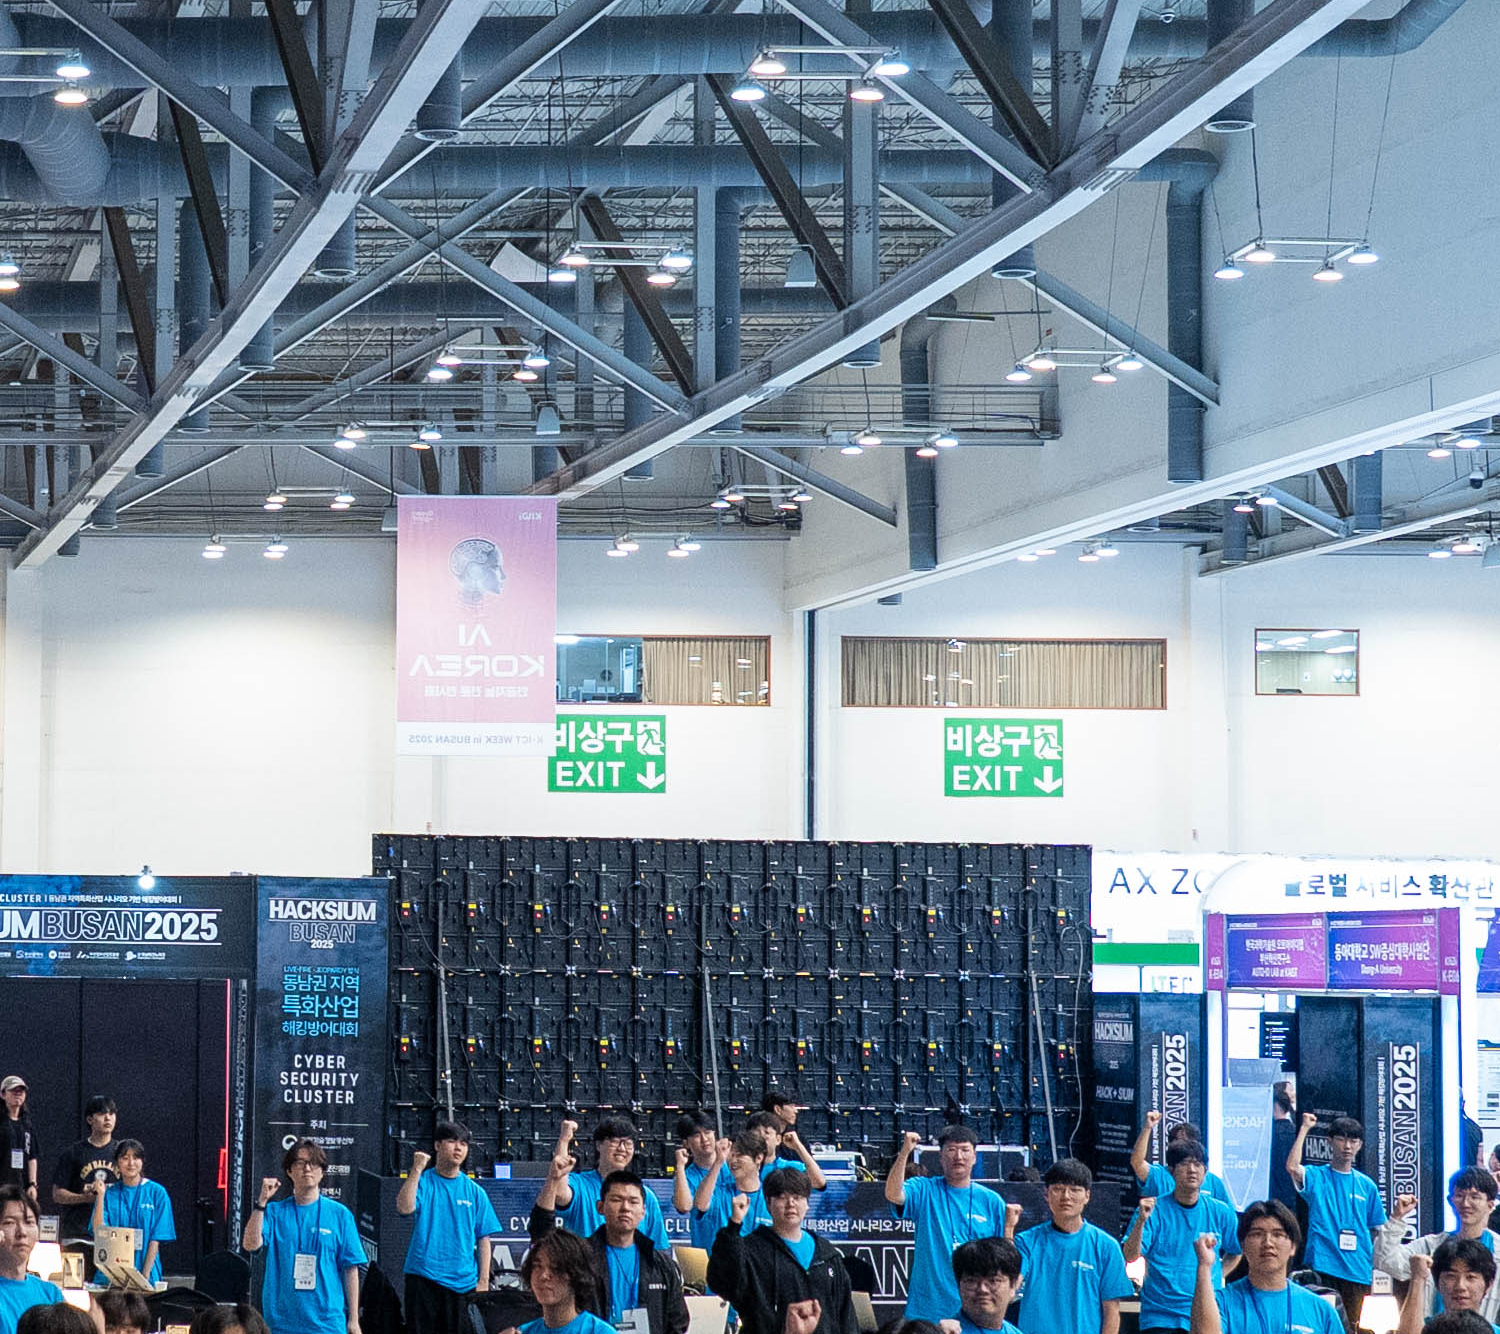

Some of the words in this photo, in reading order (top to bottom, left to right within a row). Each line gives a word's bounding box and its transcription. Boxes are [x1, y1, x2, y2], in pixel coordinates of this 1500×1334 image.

[556, 720, 635, 752] 비상구
[946, 723, 1031, 758] 비상구
[556, 761, 626, 788] EXIT
[954, 765, 1022, 792] EXIT
[1109, 868, 1158, 895] AX
[0, 893, 42, 903] CLUSTER
[269, 900, 376, 921] HACKSIUM
[289, 923, 355, 943] BUSAN
[311, 939, 334, 948] 2025
[282, 976, 327, 992] 동남권
[330, 975, 359, 992] 지역
[281, 995, 359, 1018] 특화산업
[281, 1021, 359, 1037] 해킹방어대회
[1094, 1022, 1134, 1043] HACKSIUM
[294, 1054, 345, 1069] CYBER
[280, 1072, 359, 1087] SECURITY
[284, 1089, 354, 1104] CLUSTER
[310, 1118, 327, 1130] 주최
[851, 1219, 893, 1232] 시나리오
[895, 1218, 916, 1232] 기반
